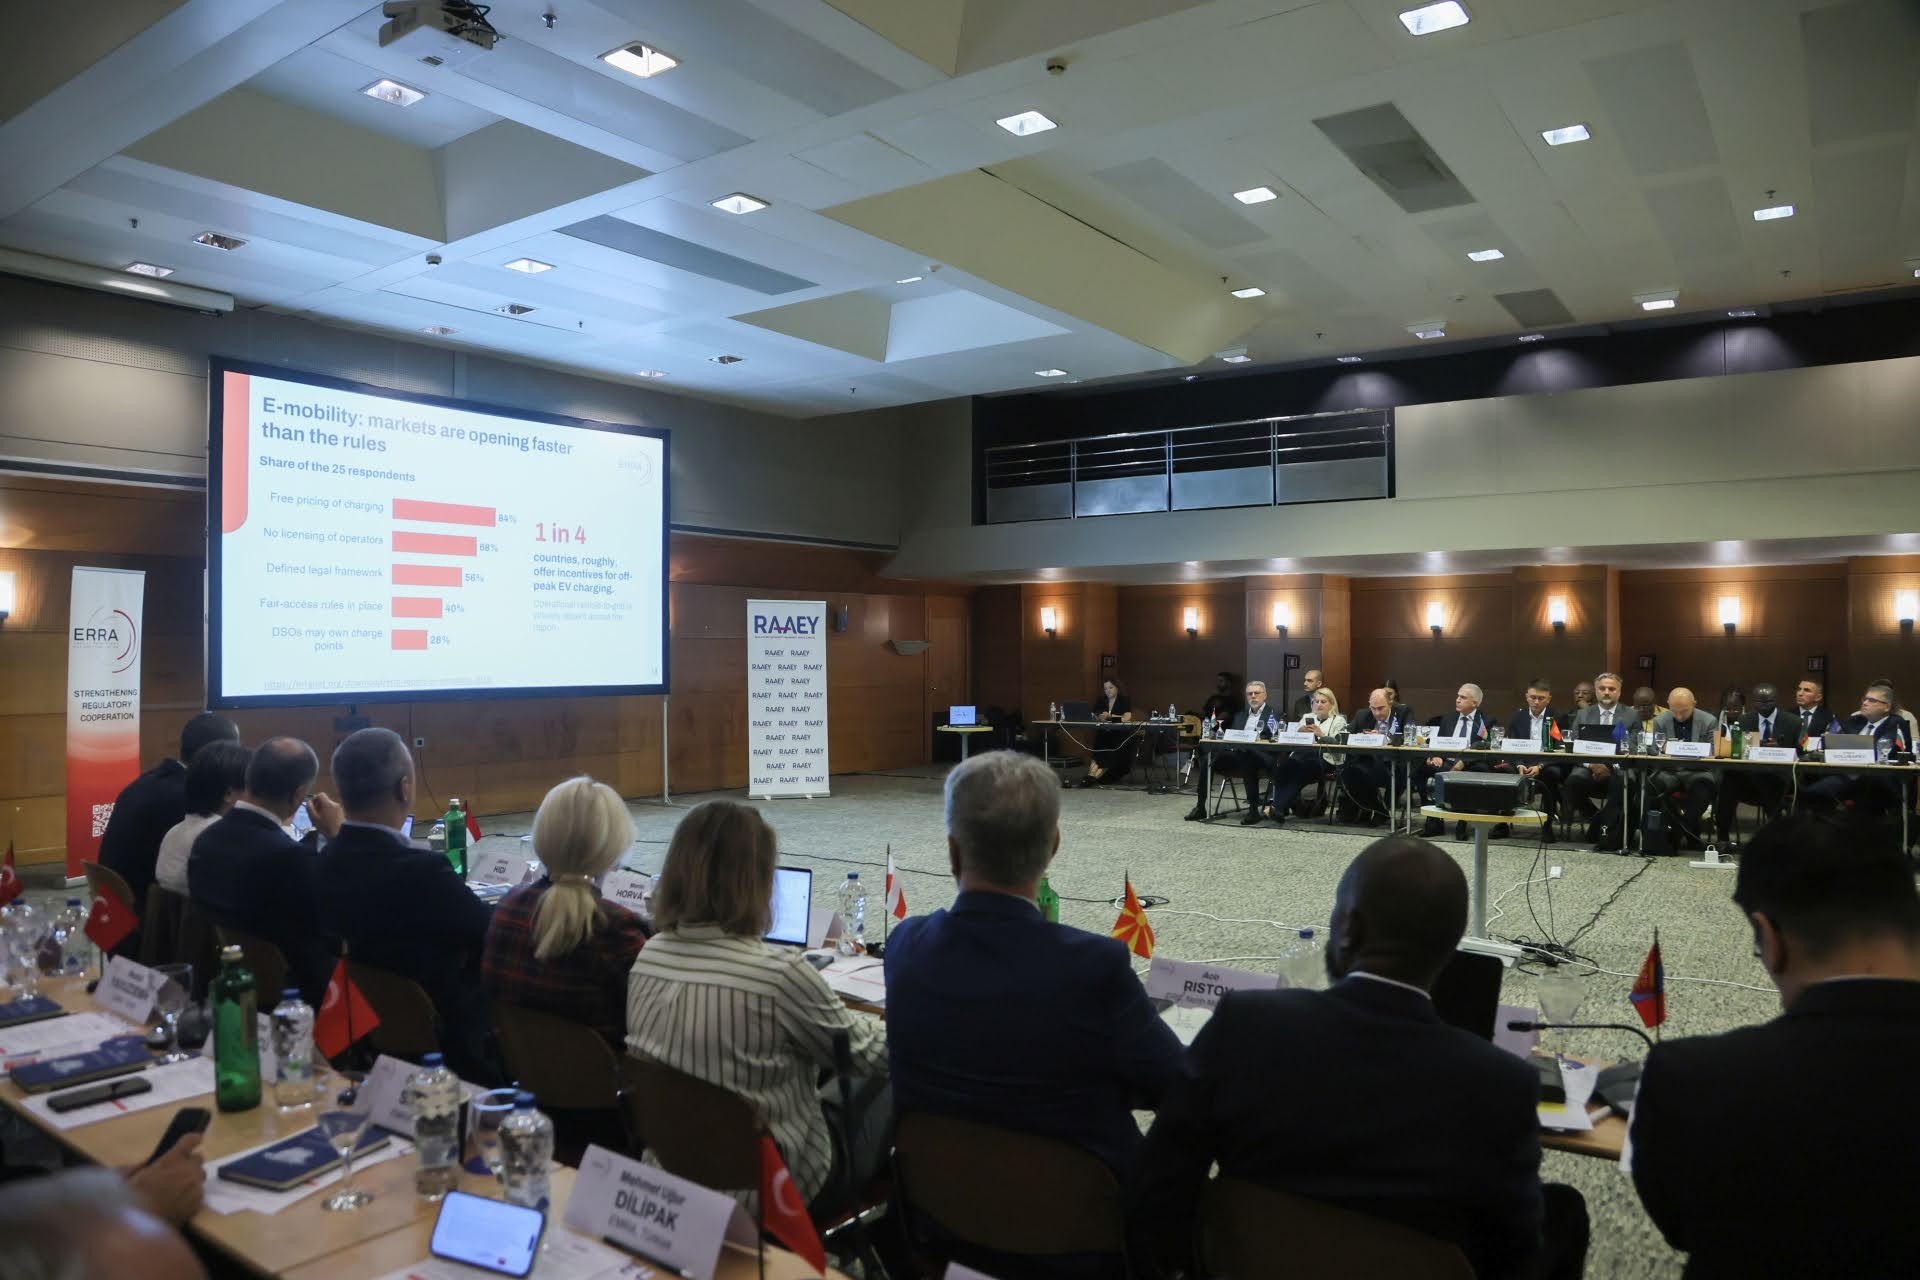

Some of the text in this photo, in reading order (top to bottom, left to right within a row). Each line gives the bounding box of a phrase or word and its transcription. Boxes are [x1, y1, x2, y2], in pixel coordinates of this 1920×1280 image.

[263, 396, 573, 455] E-mobility: markets are opening faster
[262, 422, 387, 452] than the rules
[259, 455, 416, 482] Share of the 25 respondents
[270, 491, 384, 514] Free pricing of charging
[498, 513, 517, 524] 84%
[263, 527, 384, 544] No licensing of operators
[535, 522, 587, 544] 1 in 4
[479, 543, 499, 553] 68%
[533, 554, 618, 568] countries, roughly,
[266, 562, 384, 577] Defined legal framework
[533, 567, 633, 581] offer incentives for off-
[464, 573, 484, 583] 56%
[533, 582, 615, 595] peak EV charging.
[259, 598, 383, 613] Fair-access rules in place
[754, 615, 819, 634] RAAEY
[74, 628, 119, 641] ERRA
[272, 626, 383, 641] DSOs may own charge
[429, 635, 450, 645] 28%
[314, 641, 344, 653] points
[74, 688, 138, 698] STRENGTHENING
[82, 701, 132, 710] REGULATORY
[80, 712, 134, 722] COOPERATION
